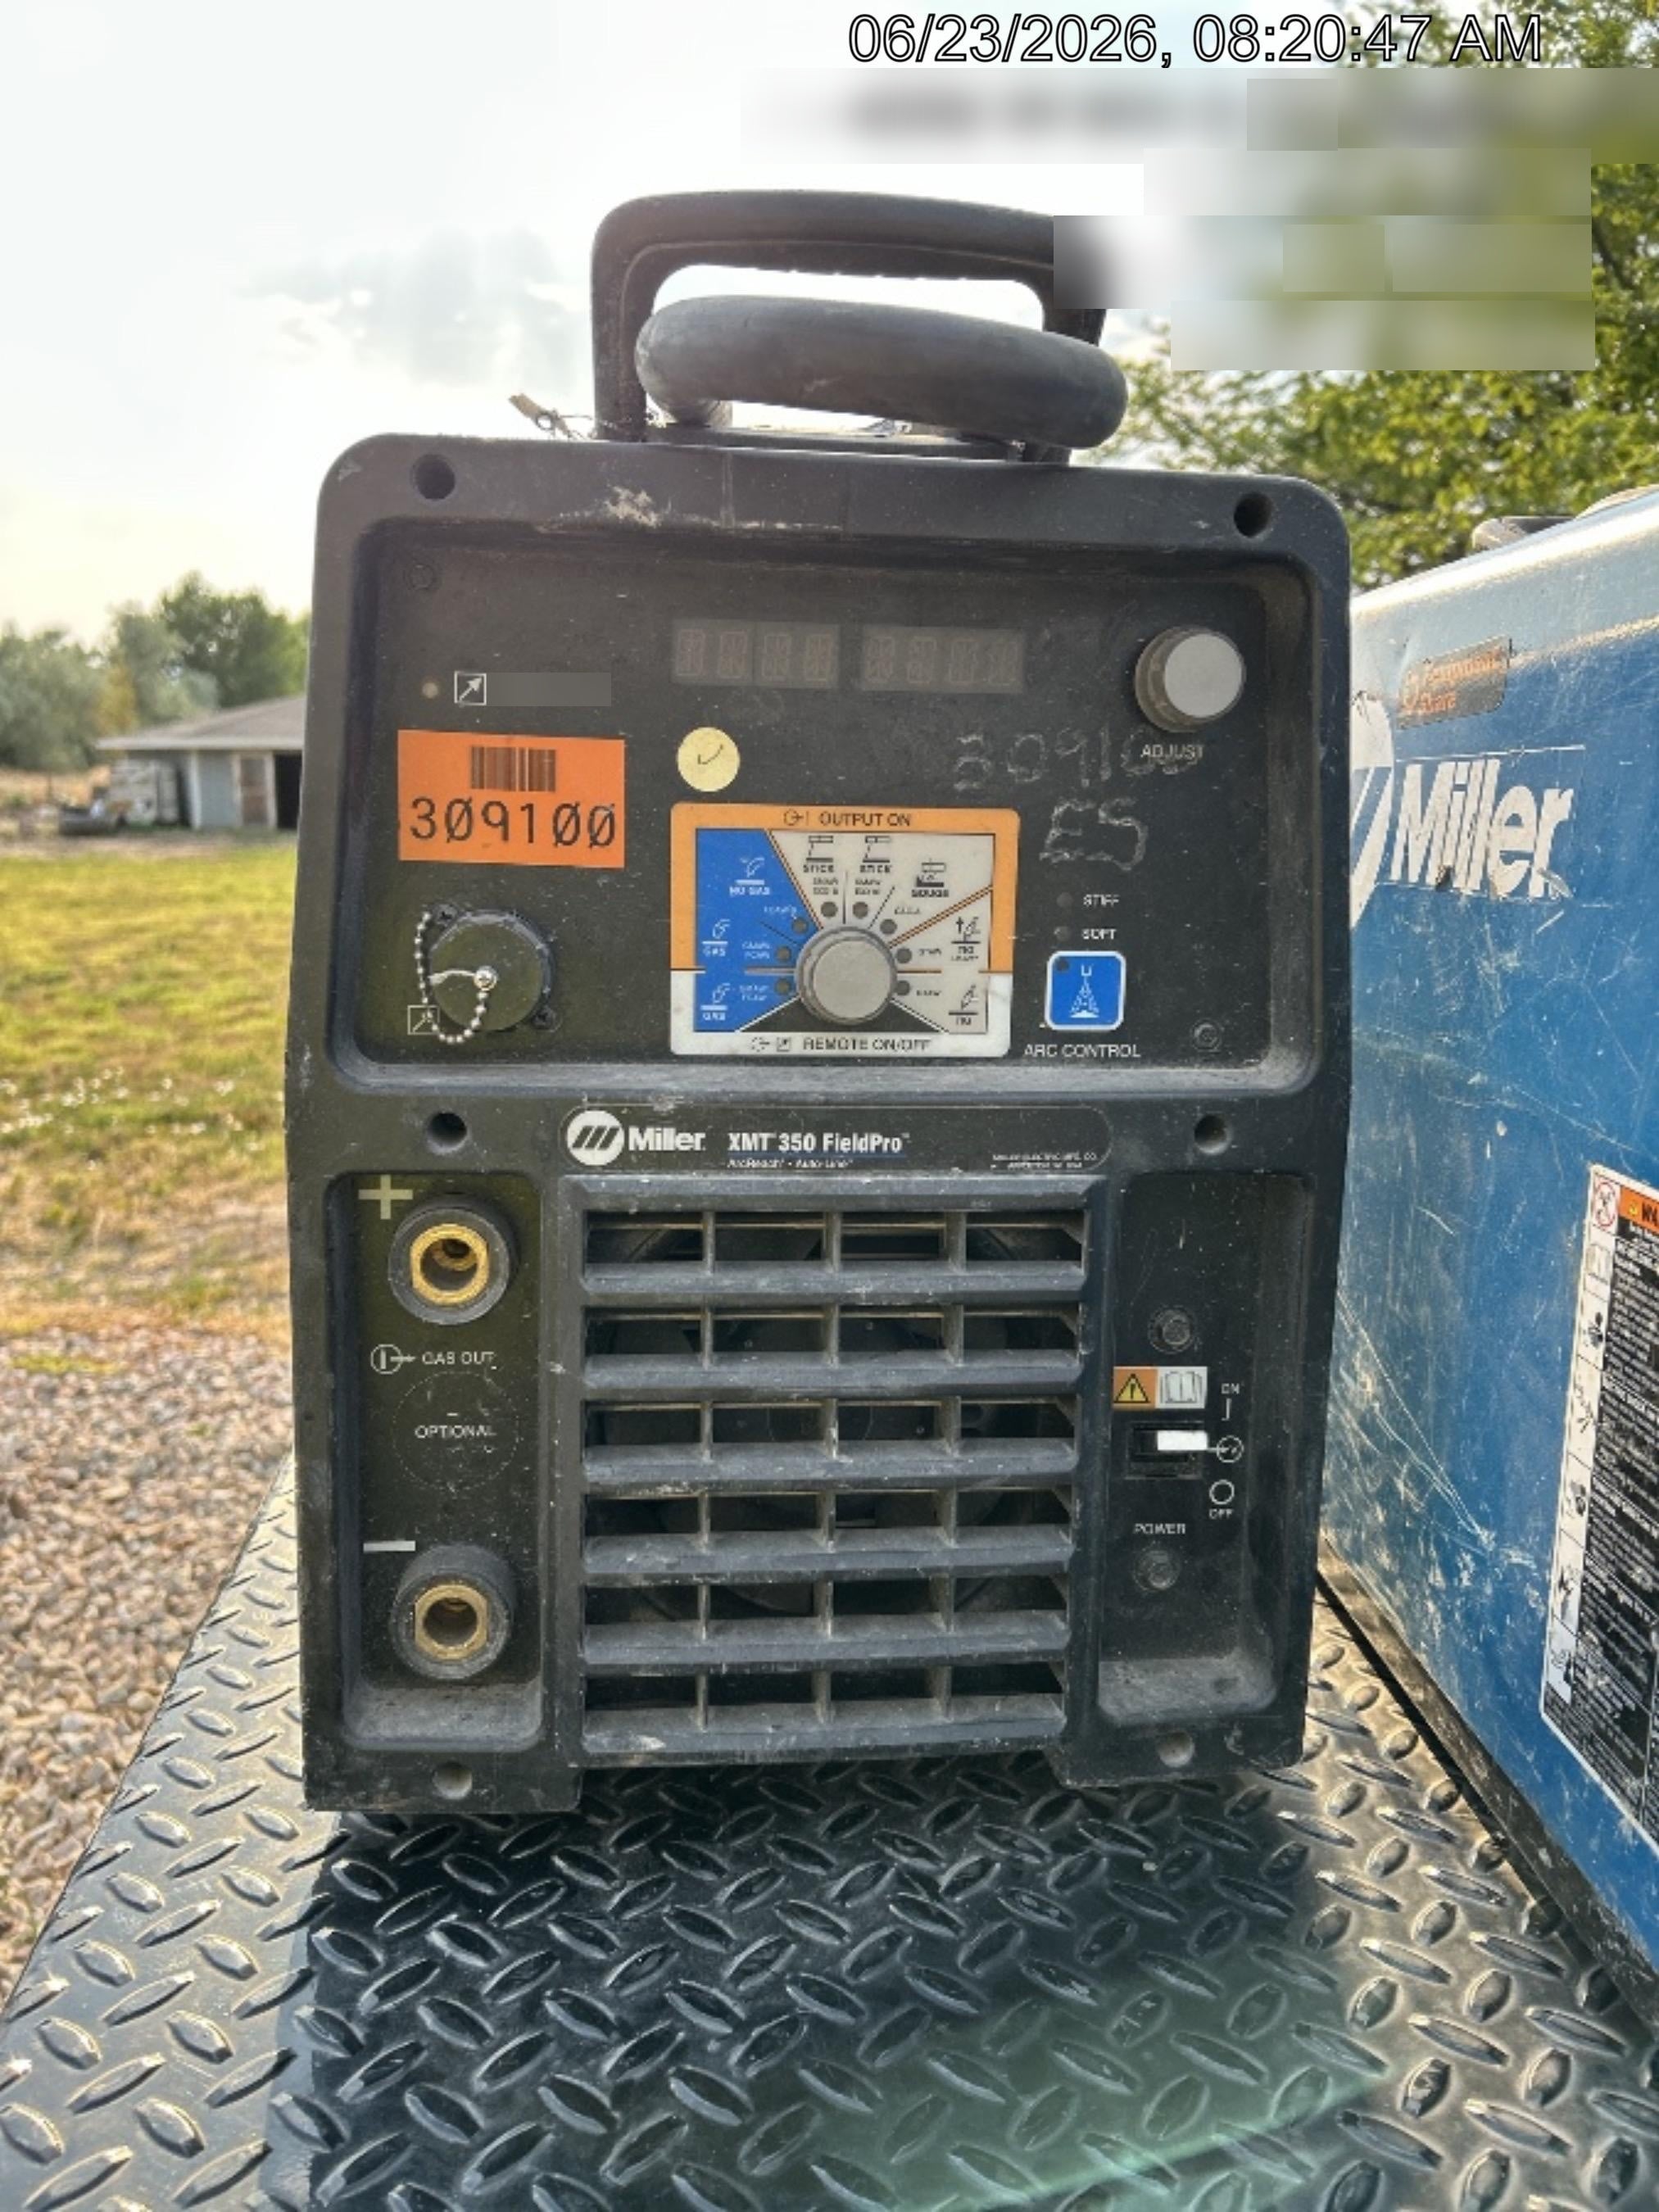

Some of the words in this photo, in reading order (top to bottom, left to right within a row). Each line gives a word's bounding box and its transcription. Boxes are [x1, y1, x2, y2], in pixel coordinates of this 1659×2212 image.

[1140, 743, 1204, 762] ADJUST
[410, 796, 617, 849] 309100
[819, 810, 882, 827] OUTPUT
[887, 813, 912, 827] ON
[1389, 758, 1574, 900] Miller
[802, 1037, 868, 1051] REMOTE
[1024, 1045, 1058, 1058] ARC
[1063, 1045, 1142, 1058] CONTROL
[628, 1126, 706, 1152] Miller
[778, 1132, 814, 1153] 350
[421, 1352, 456, 1365] GAS
[460, 1352, 495, 1365] OUT
[415, 1424, 496, 1439] OPTIONAL
[1134, 1523, 1185, 1534] POWER
